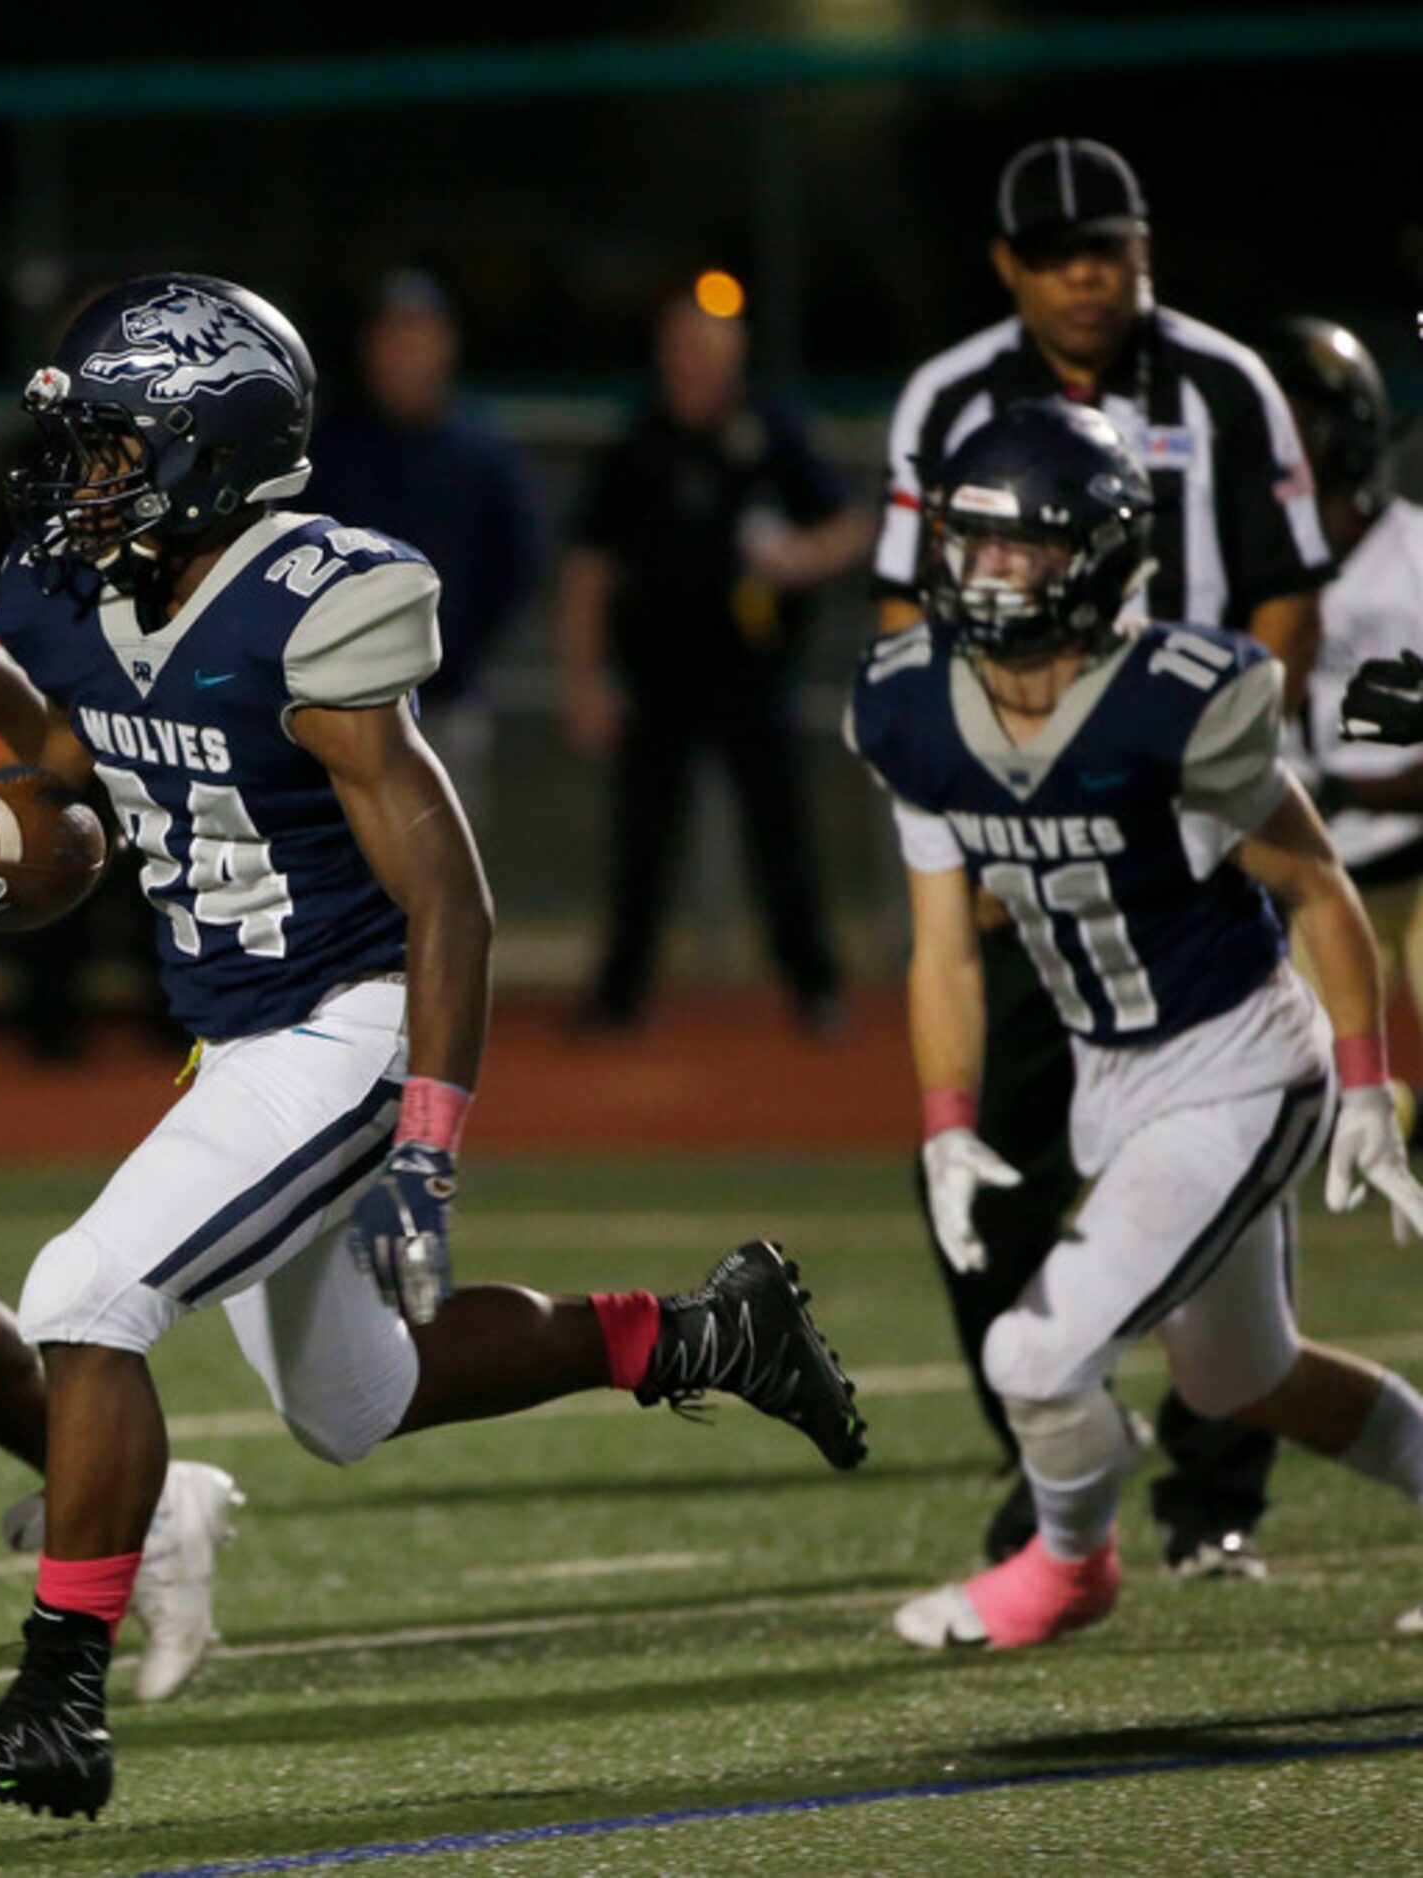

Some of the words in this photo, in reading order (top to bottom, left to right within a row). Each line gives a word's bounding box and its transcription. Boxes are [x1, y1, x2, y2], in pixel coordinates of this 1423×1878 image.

[1148, 630, 1237, 692] 11
[80, 705, 233, 775] WOLVES
[946, 810, 1126, 857] WOLVES
[981, 861, 1158, 1034] 11
